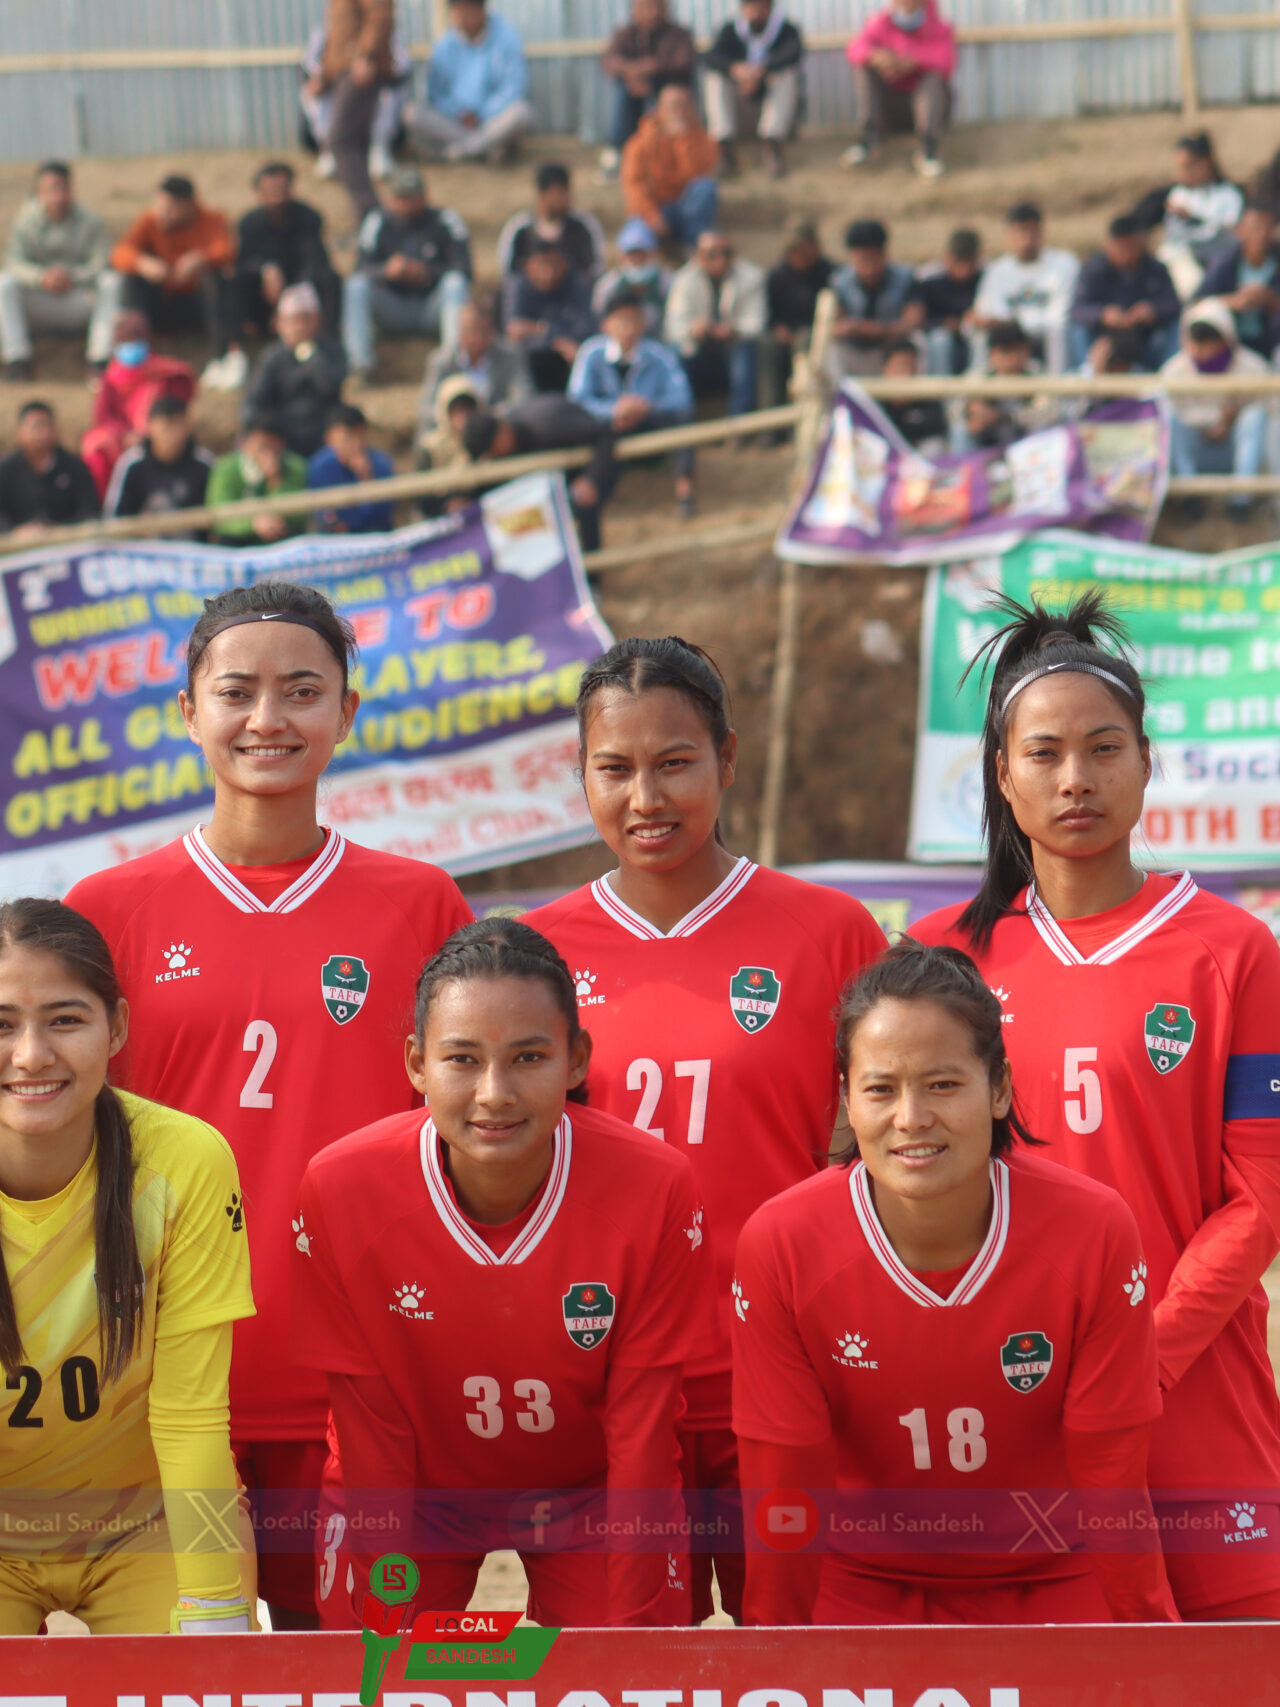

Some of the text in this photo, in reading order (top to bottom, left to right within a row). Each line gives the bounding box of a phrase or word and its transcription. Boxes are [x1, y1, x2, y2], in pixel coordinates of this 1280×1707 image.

[404, 582, 496, 641] TO
[350, 633, 547, 704] LAYERS,
[12, 716, 114, 780] ALL
[1183, 750, 1280, 782] Soc
[4, 753, 217, 841] OFFICIA
[1143, 807, 1237, 844] OTH
[155, 967, 200, 984] KELME
[329, 987, 360, 1003] TAFC
[577, 994, 606, 1007] LME
[737, 998, 770, 1013] TAFC
[1151, 1036, 1184, 1054] TAFC
[239, 1020, 278, 1109] 2
[626, 1057, 712, 1145] 27
[1064, 1047, 1103, 1134] 5
[388, 1303, 435, 1321] KELME
[572, 1317, 607, 1330] TAFC
[831, 1353, 879, 1369] KELME
[1010, 1361, 1045, 1375] TAFC
[5, 1355, 101, 1428] 20
[463, 1375, 556, 1440] 33
[899, 1407, 988, 1473] 18
[1223, 1528, 1269, 1544] KELME
